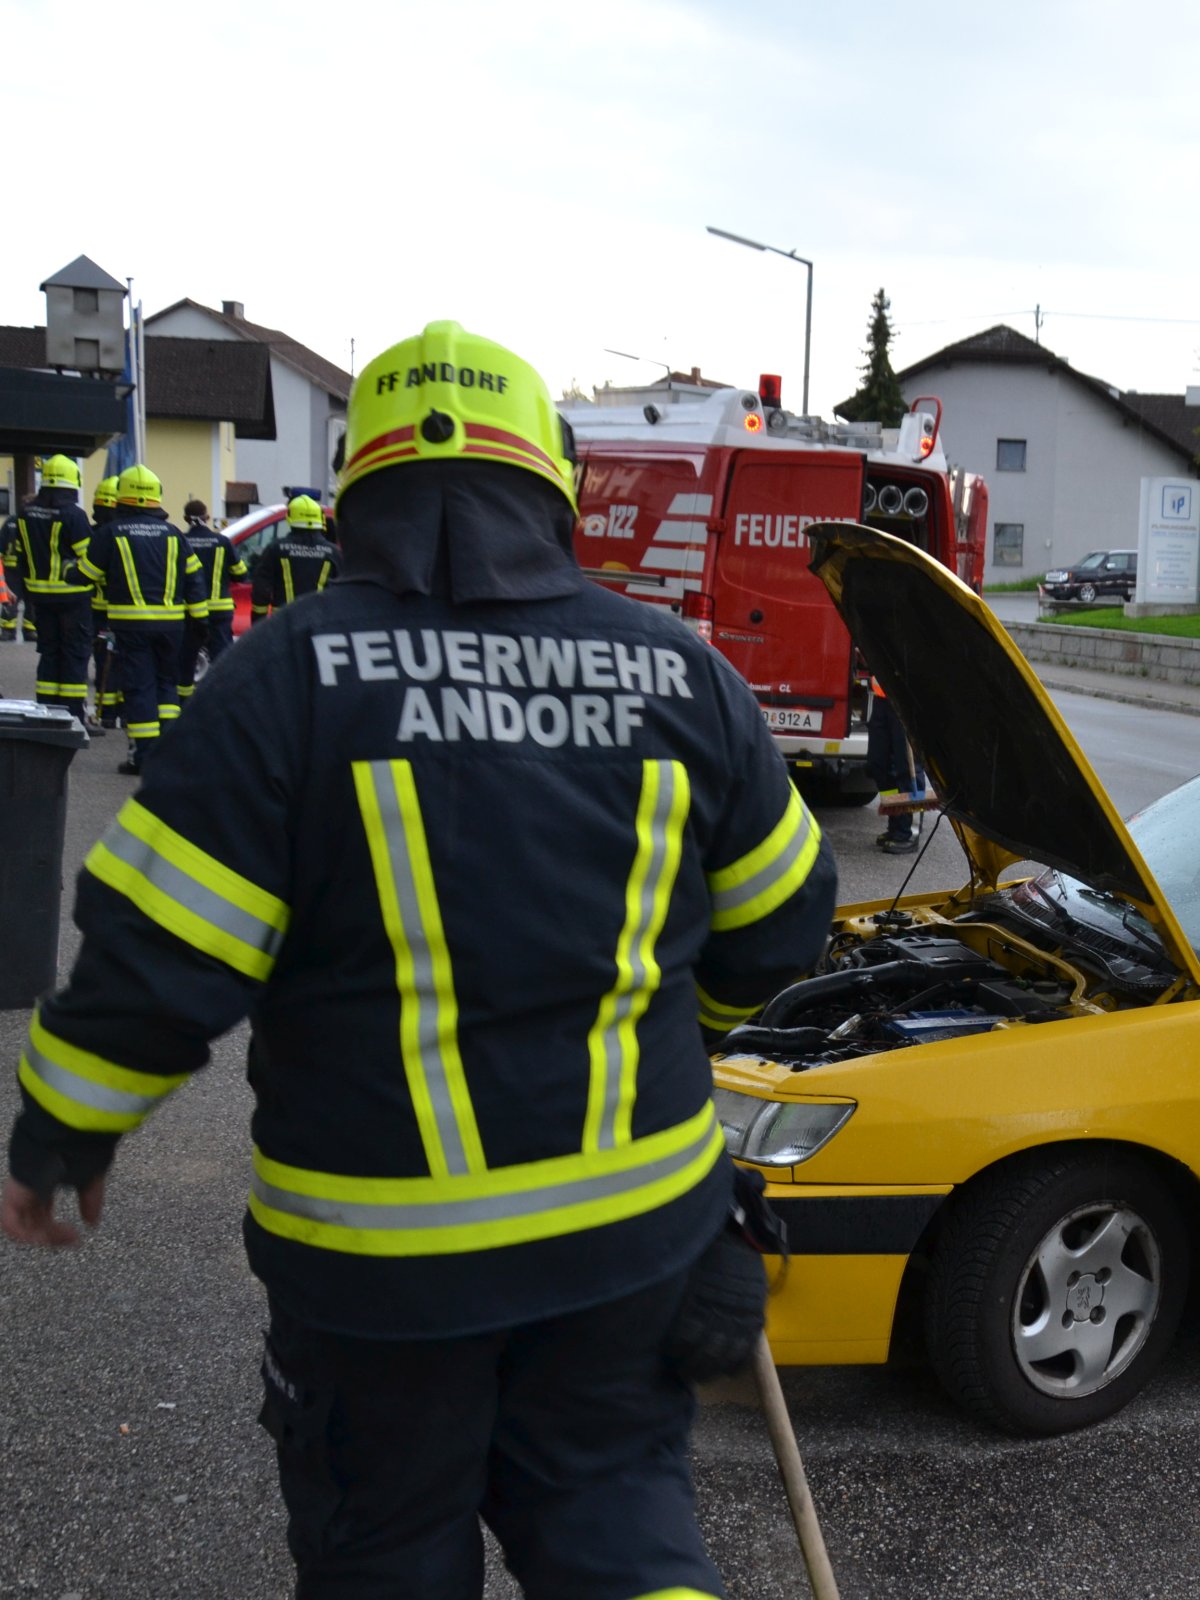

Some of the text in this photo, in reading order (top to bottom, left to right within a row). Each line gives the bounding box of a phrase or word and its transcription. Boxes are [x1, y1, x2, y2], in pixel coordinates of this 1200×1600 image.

[376, 362, 508, 395] FF ANDORF
[607, 504, 639, 539] 122
[734, 513, 857, 548] FEUER
[312, 629, 694, 699] FEUERWEHR
[750, 682, 791, 692] bauer CL
[396, 687, 645, 748] ANDORF
[779, 712, 800, 726] 912
[803, 714, 811, 727] A
